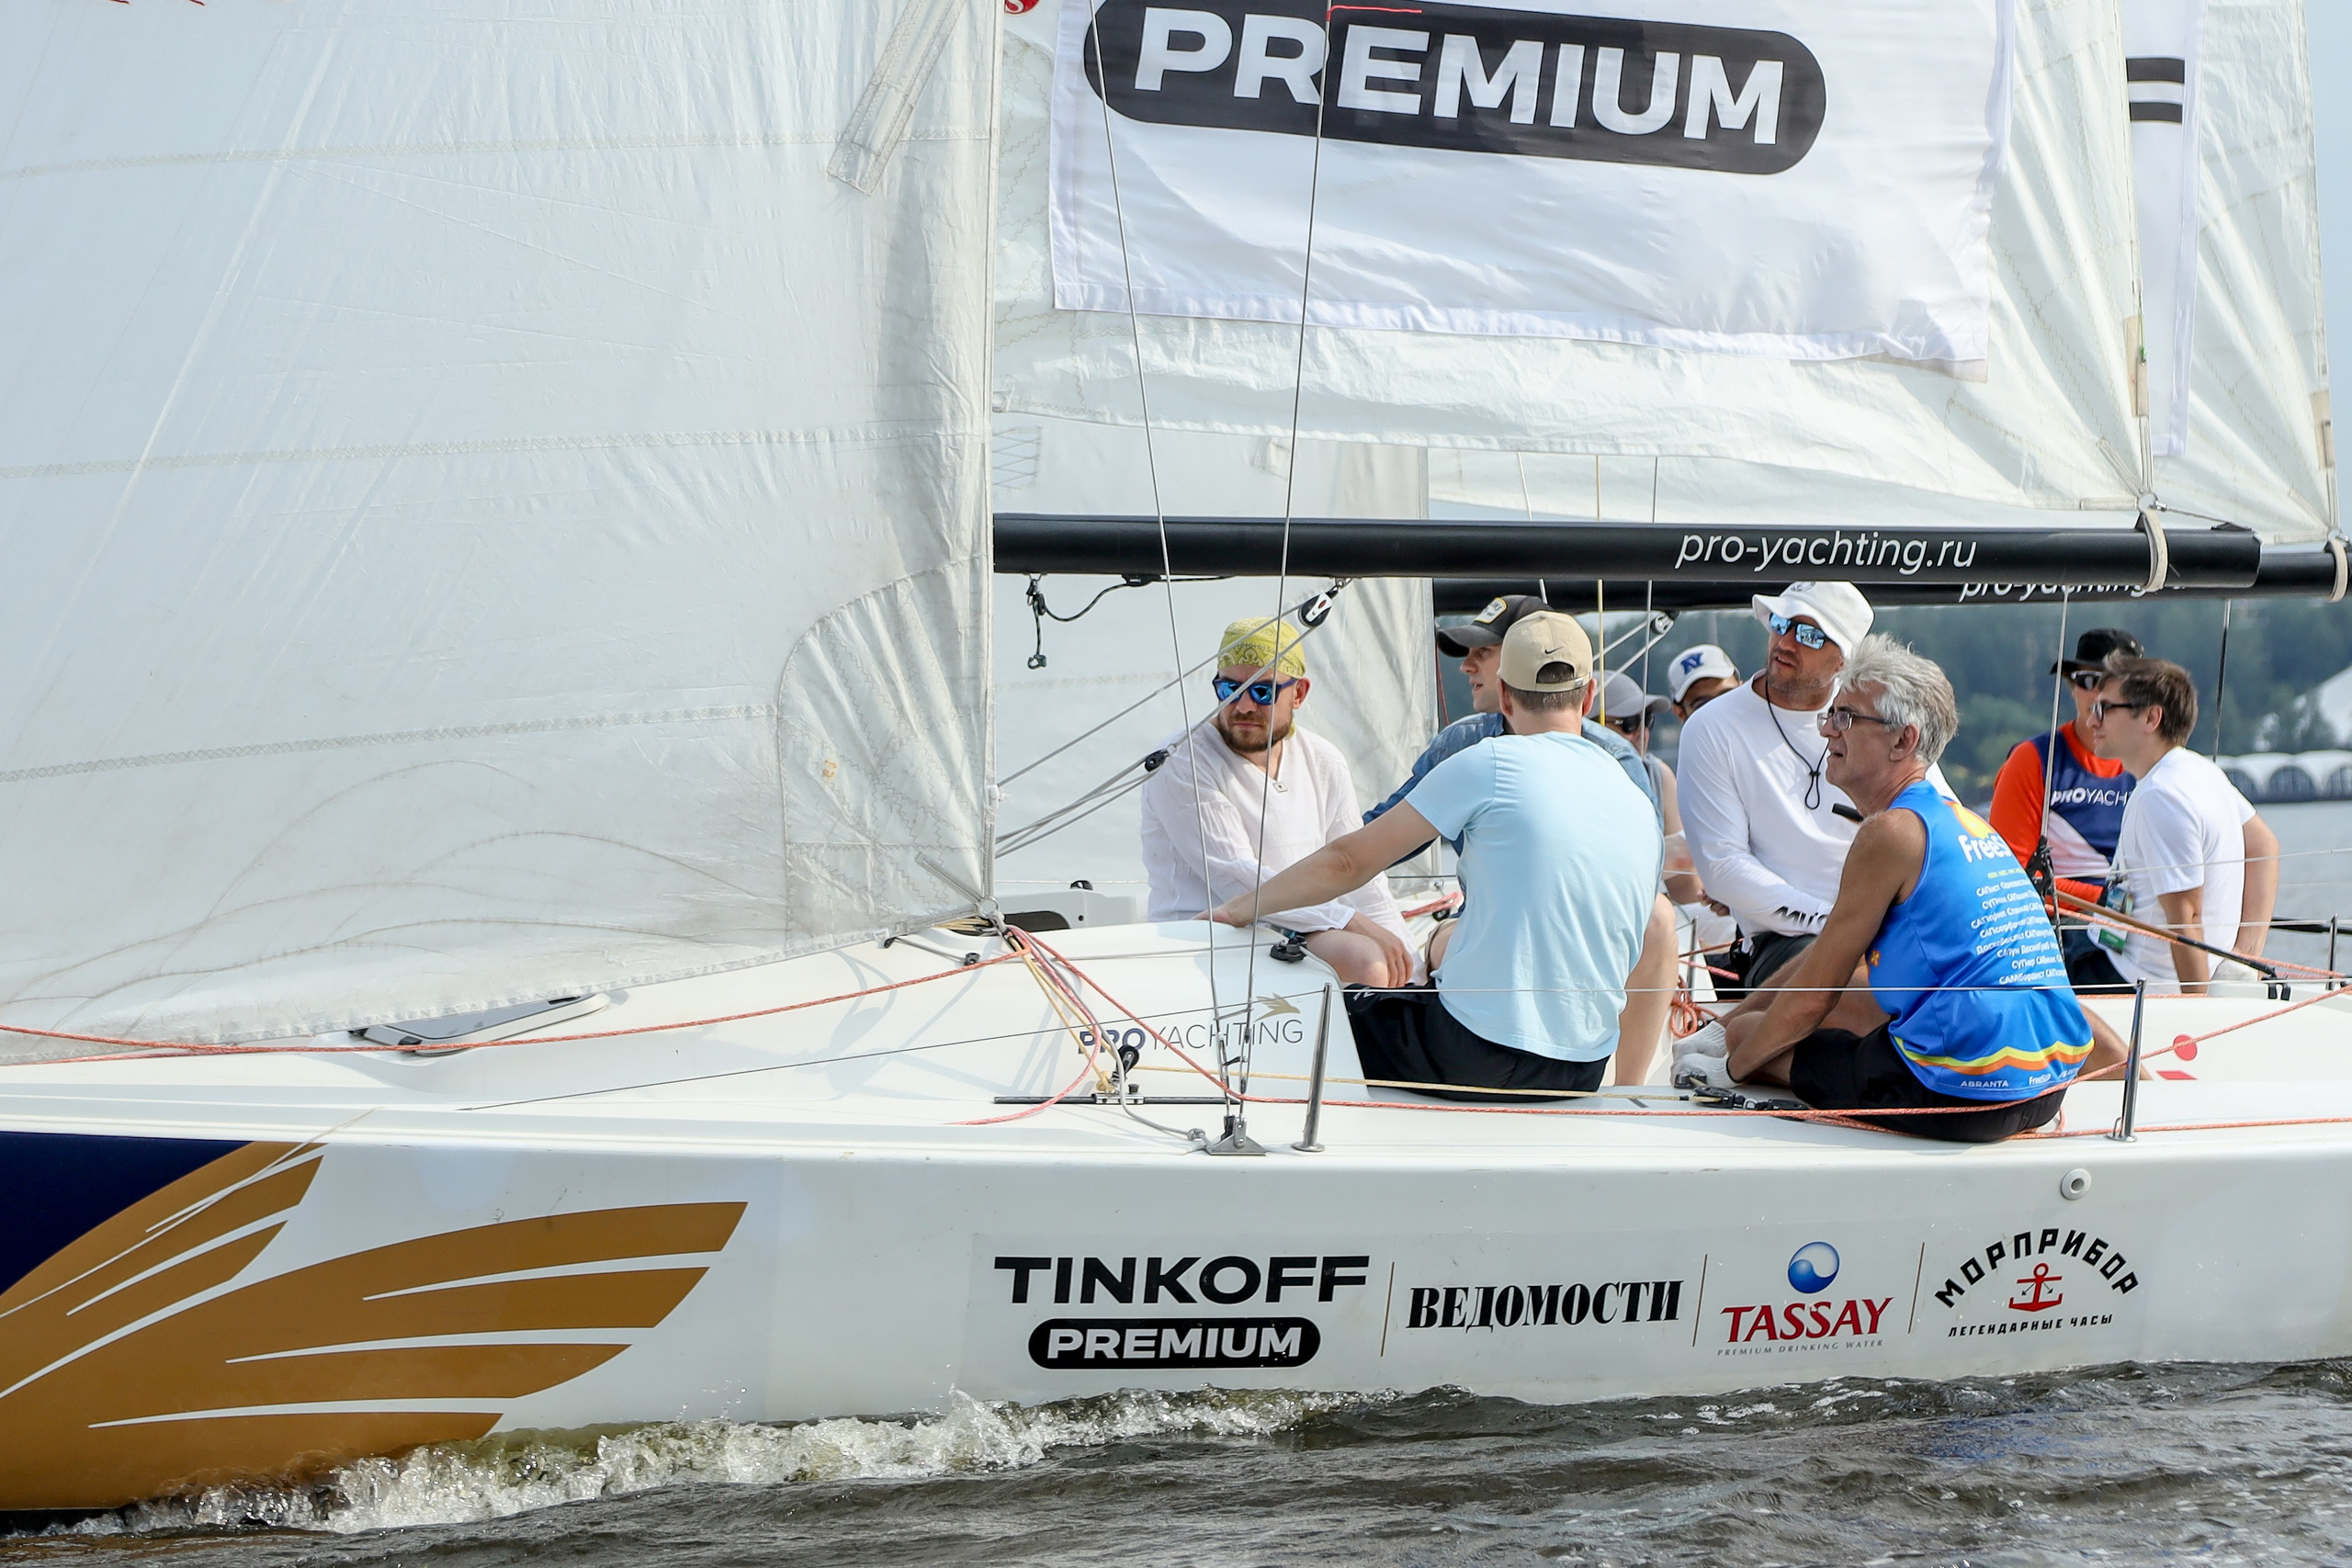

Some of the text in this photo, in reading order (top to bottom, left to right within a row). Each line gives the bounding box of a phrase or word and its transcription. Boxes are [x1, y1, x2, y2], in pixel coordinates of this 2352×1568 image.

[1135, 7, 1784, 145] PREMIUM
[1675, 530, 1976, 576] pro-yachting.ru
[2050, 787, 2131, 807] PROYACH
[1961, 1080, 2009, 1089] ABRANTA
[994, 1256, 1370, 1304] TINKOFF
[1934, 1228, 2139, 1308] МОРПРИБОР
[1406, 1280, 1684, 1334] ВЕДОМОСТИ
[1720, 1297, 1894, 1343] TASSAY
[1948, 1314, 2113, 1337] ЛЕГЕНДАРНЫЕ ЧАСЫ
[1046, 1326, 1302, 1359] PREMIUM
[1717, 1339, 1883, 1357] PREMIUM DRINKING WATER
